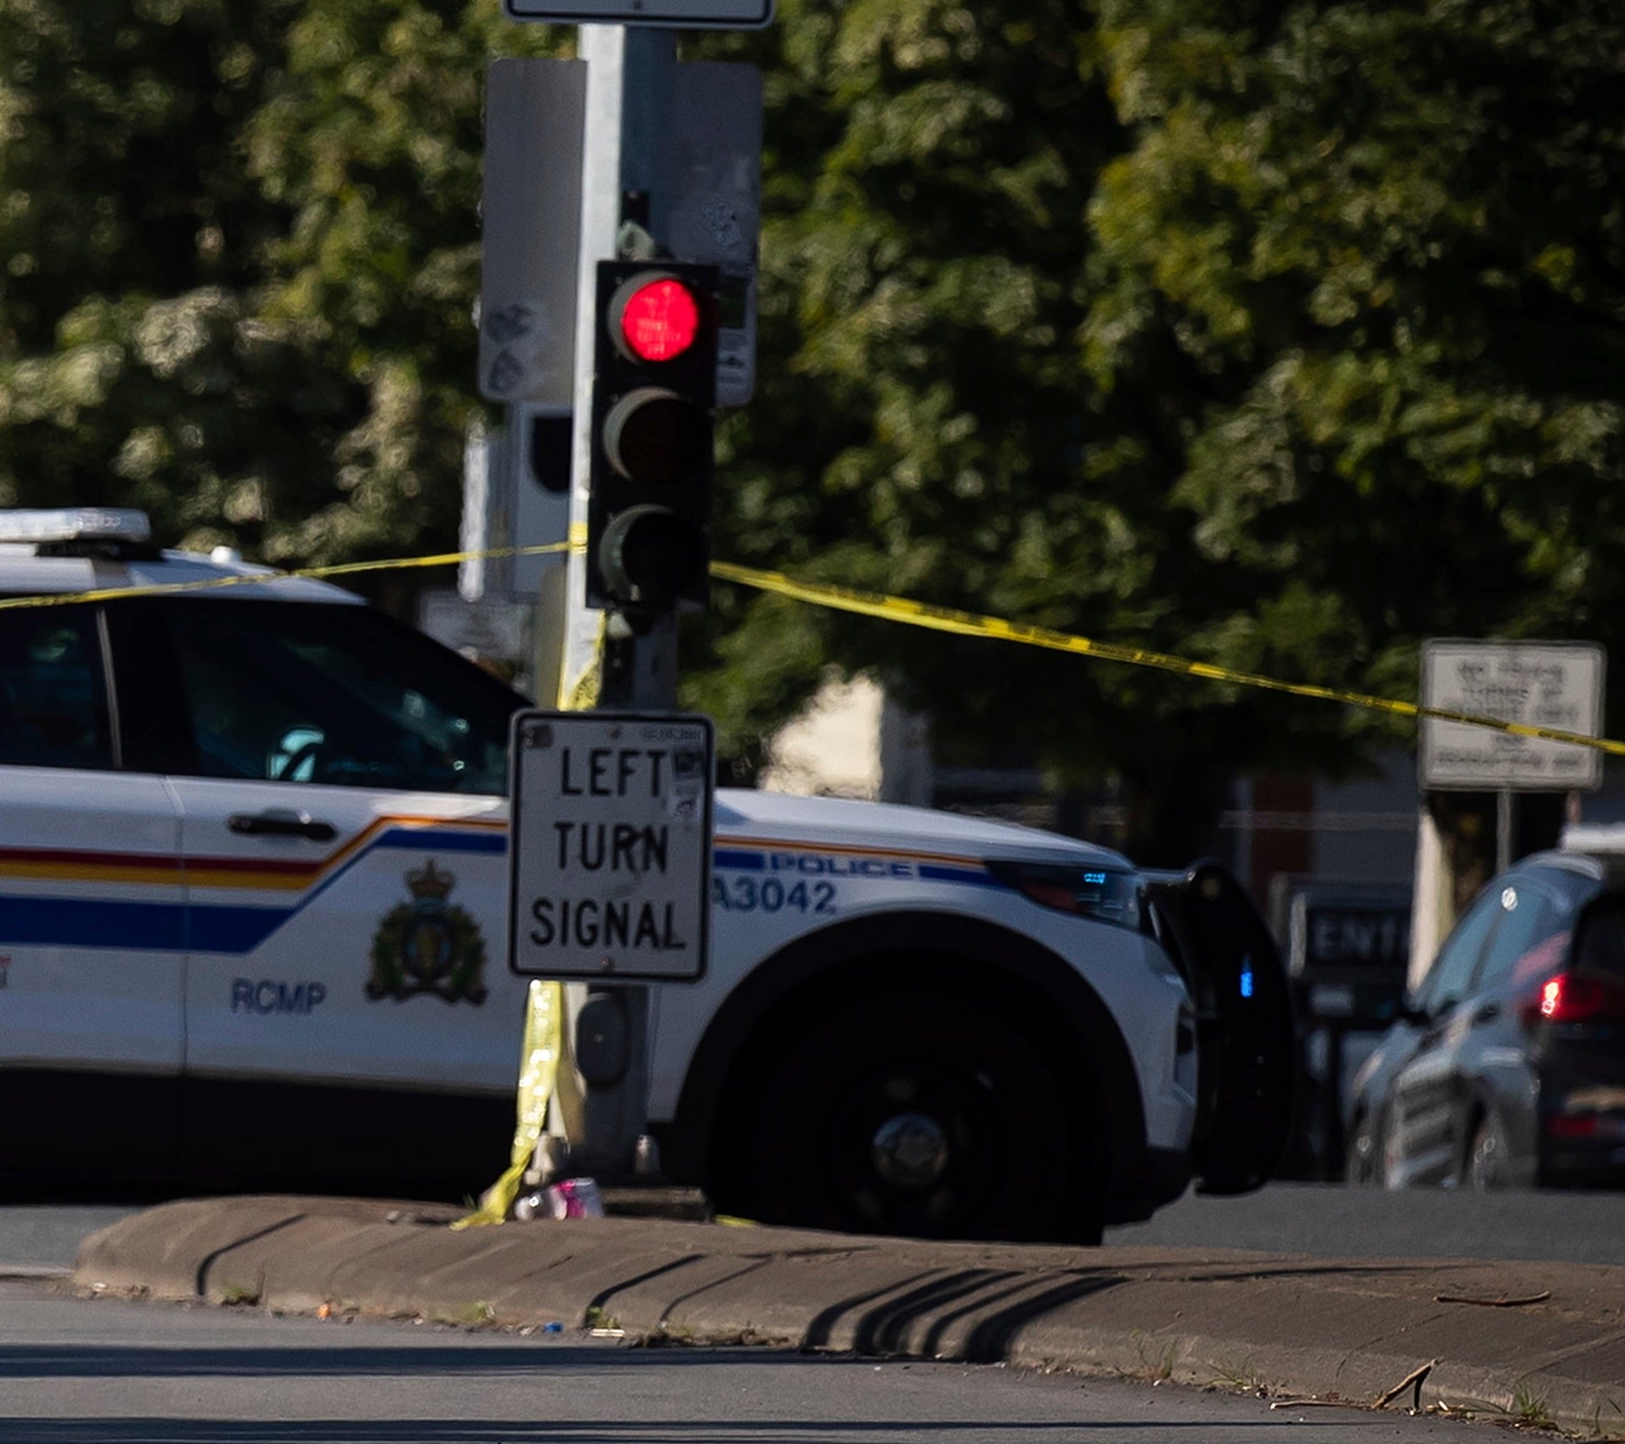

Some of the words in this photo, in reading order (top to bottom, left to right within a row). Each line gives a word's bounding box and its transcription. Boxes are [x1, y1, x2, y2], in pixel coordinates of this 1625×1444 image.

[560, 747, 668, 797] LEFT
[553, 821, 669, 873] TURN
[770, 853, 913, 877] POLICE
[530, 897, 686, 949] SIGNAL
[230, 979, 325, 1015] RCMP
